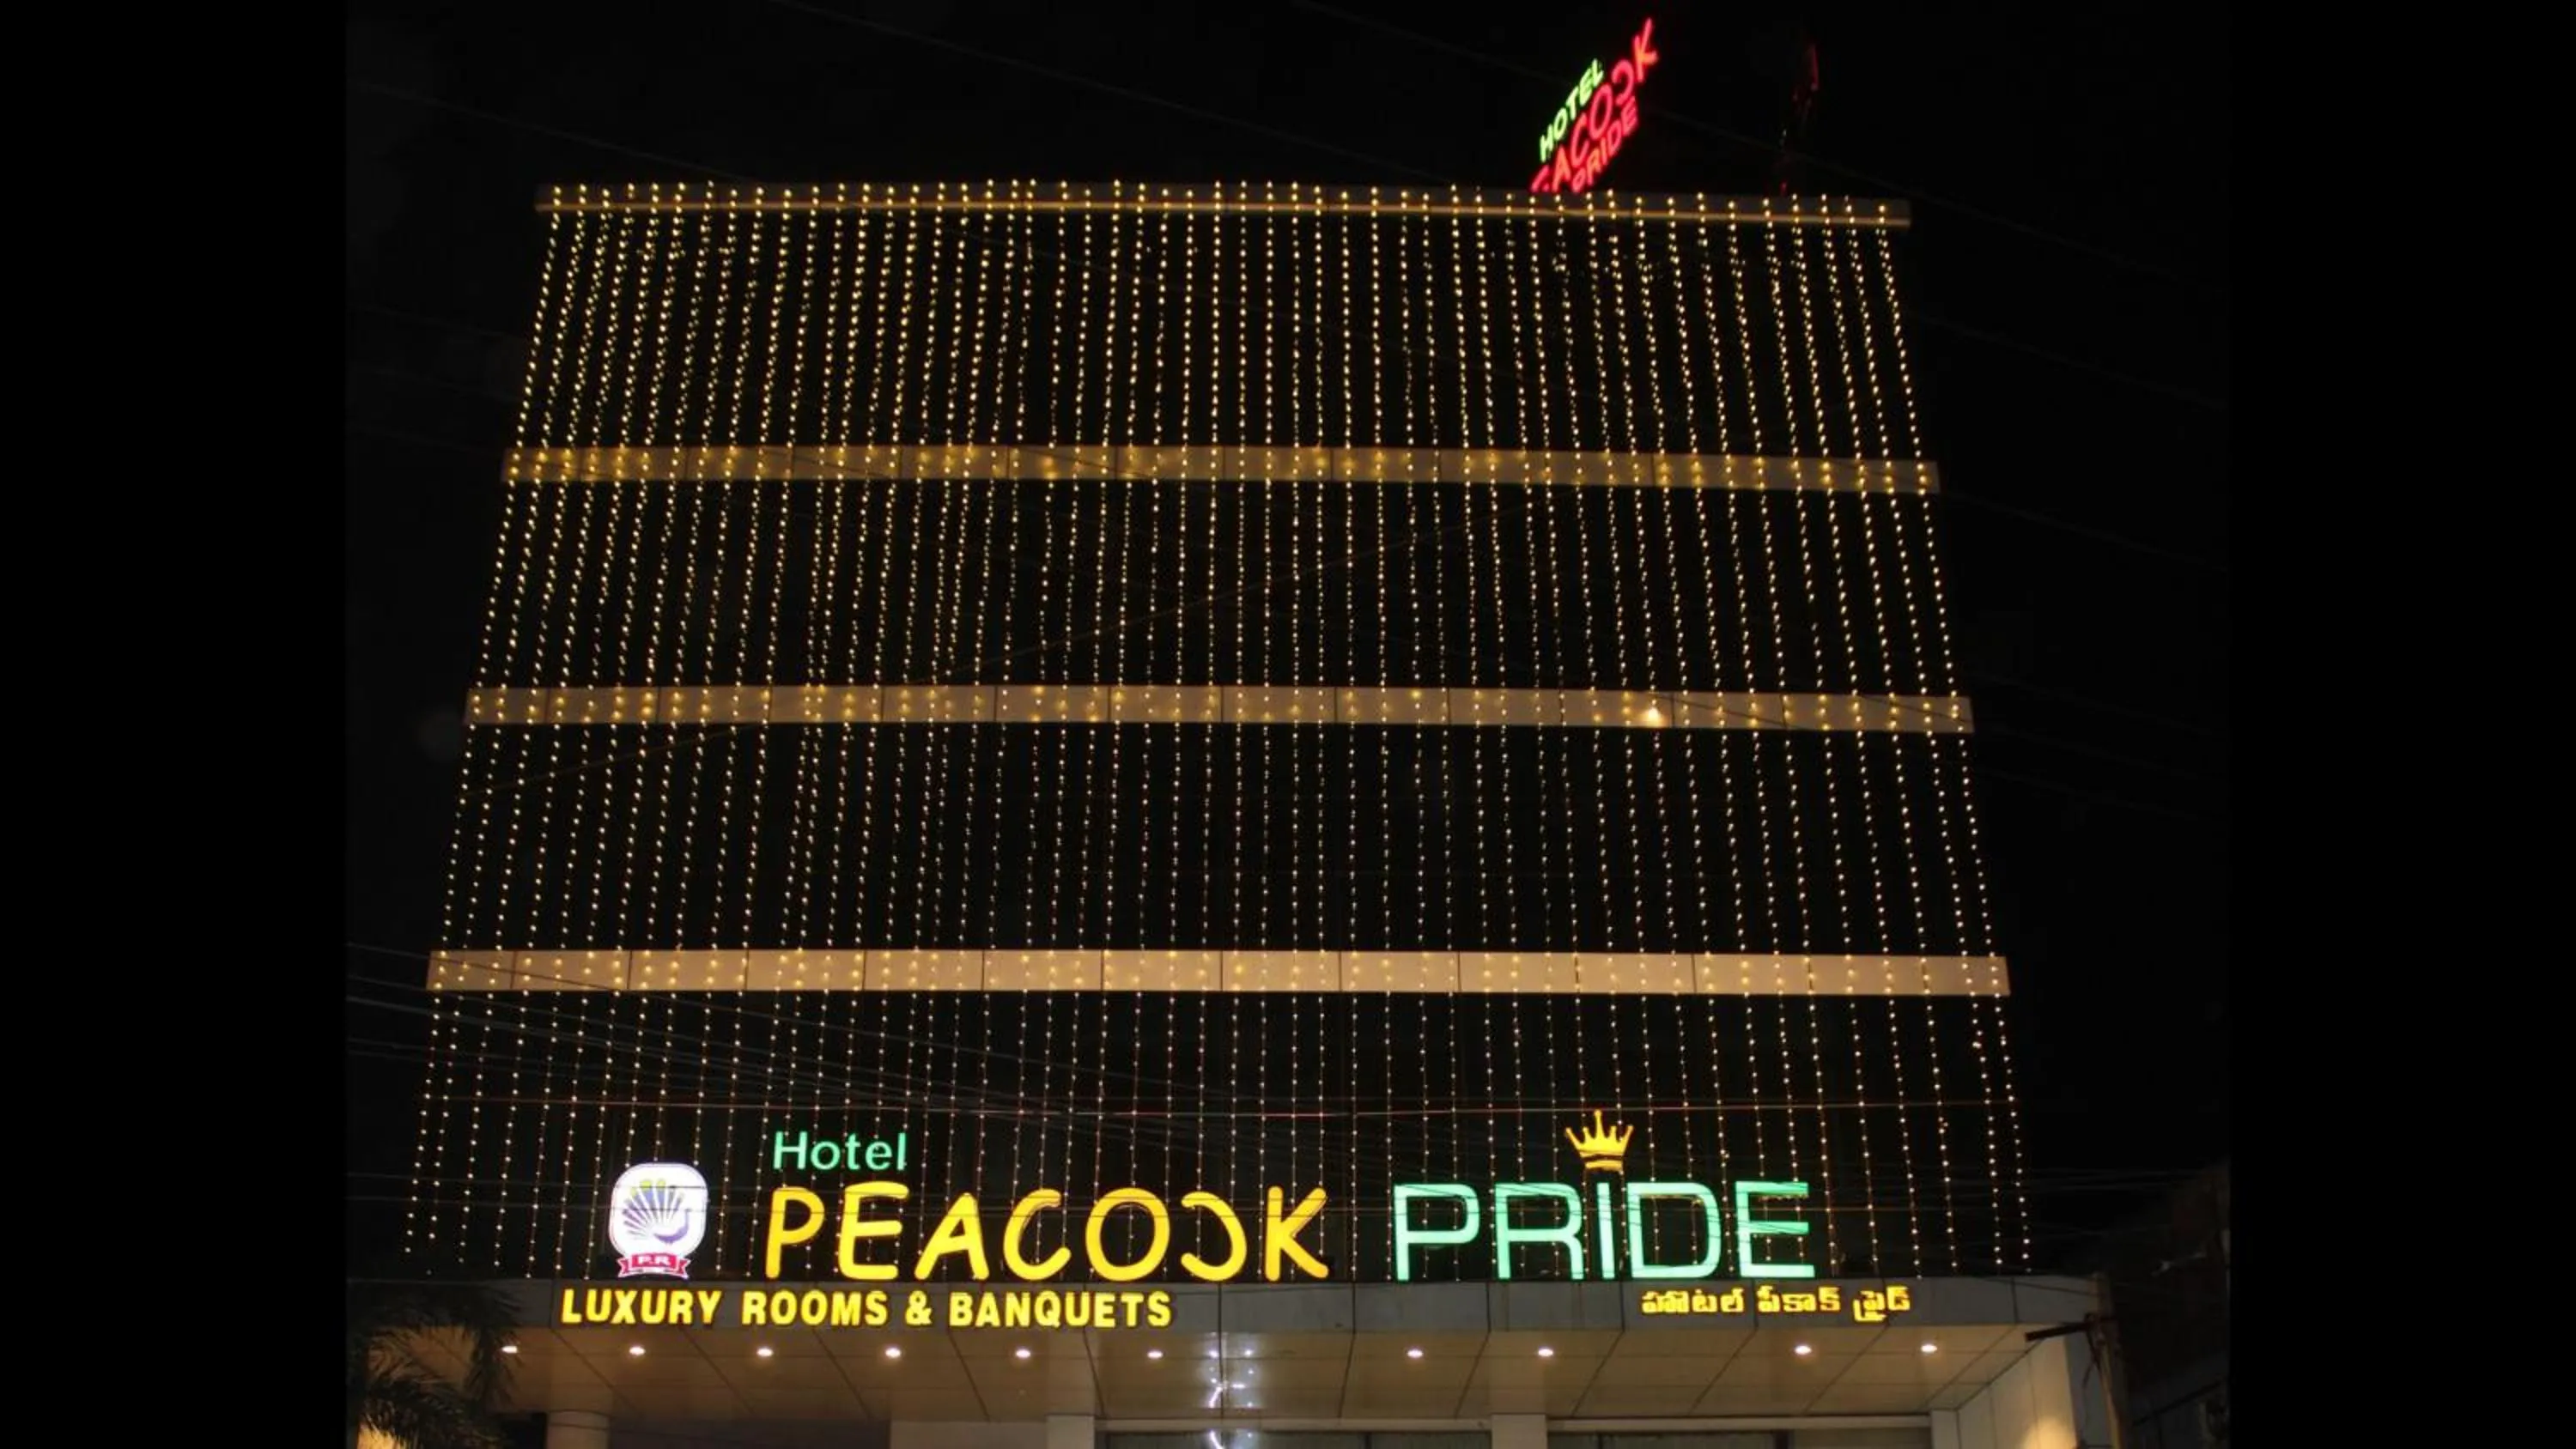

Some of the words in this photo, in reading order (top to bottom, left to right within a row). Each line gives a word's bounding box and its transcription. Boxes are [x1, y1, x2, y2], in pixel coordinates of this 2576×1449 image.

[1540, 58, 1604, 161] HOTEL
[774, 1131, 906, 1170] Hotel
[766, 1181, 1327, 1281] PEACOCK
[1394, 1181, 1814, 1281] PRIDE
[562, 1289, 721, 1325] LUXURY
[742, 1290, 887, 1325] ROOMS
[905, 1290, 932, 1326] &
[950, 1290, 1171, 1328] BANQUETS
[1642, 1288, 1745, 1313] హోటల్
